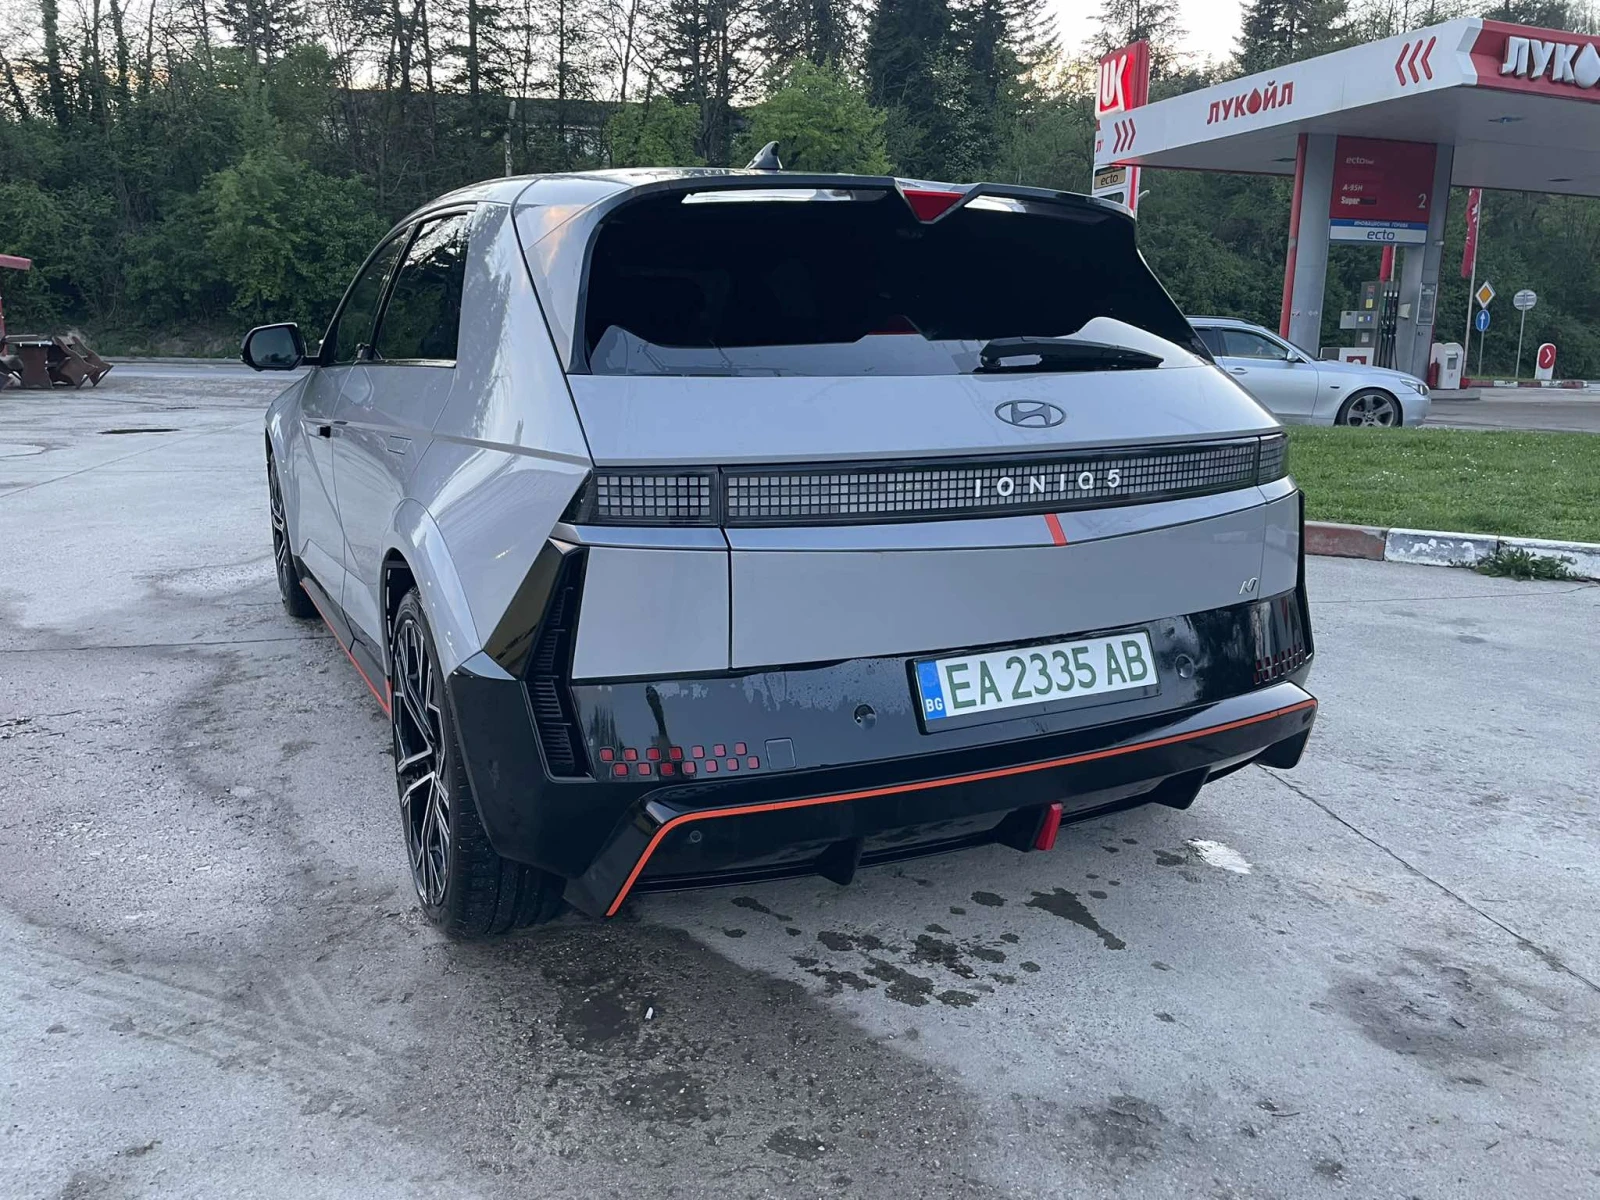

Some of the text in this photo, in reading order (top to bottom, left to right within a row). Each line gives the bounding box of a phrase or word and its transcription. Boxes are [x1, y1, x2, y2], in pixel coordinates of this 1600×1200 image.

[1207, 80, 1294, 125] ЛУКОЙЛ
[1100, 173, 1119, 186] ecto
[1341, 196, 1361, 206] Super
[1418, 193, 1427, 209] 2
[1366, 229, 1395, 240] ecto
[974, 469, 1120, 498] IONIQ 5
[945, 639, 1148, 710] EA 2335 AB
[926, 697, 943, 713] BG
